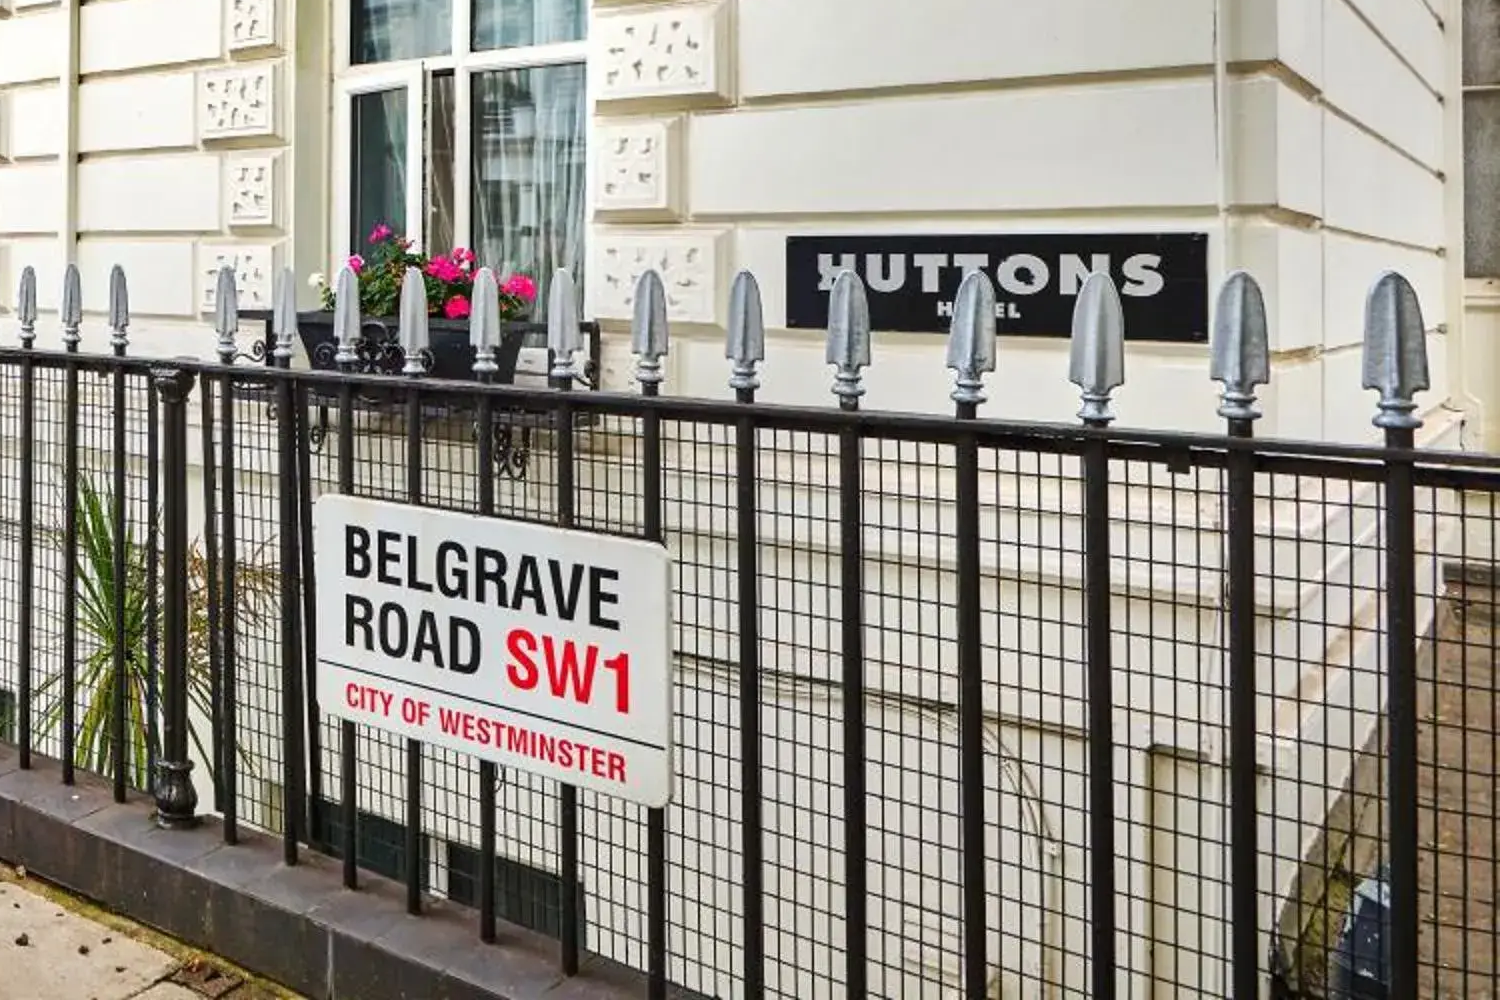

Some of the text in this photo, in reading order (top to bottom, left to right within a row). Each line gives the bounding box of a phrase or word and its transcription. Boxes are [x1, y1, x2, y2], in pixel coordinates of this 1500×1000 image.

[816, 252, 1165, 297] HUTTONS
[936, 300, 1022, 319] HEL
[345, 524, 620, 631] BELGRAVE
[345, 593, 631, 716] ROAD SW1
[345, 681, 627, 783] CITY OF WESTMINSTER
